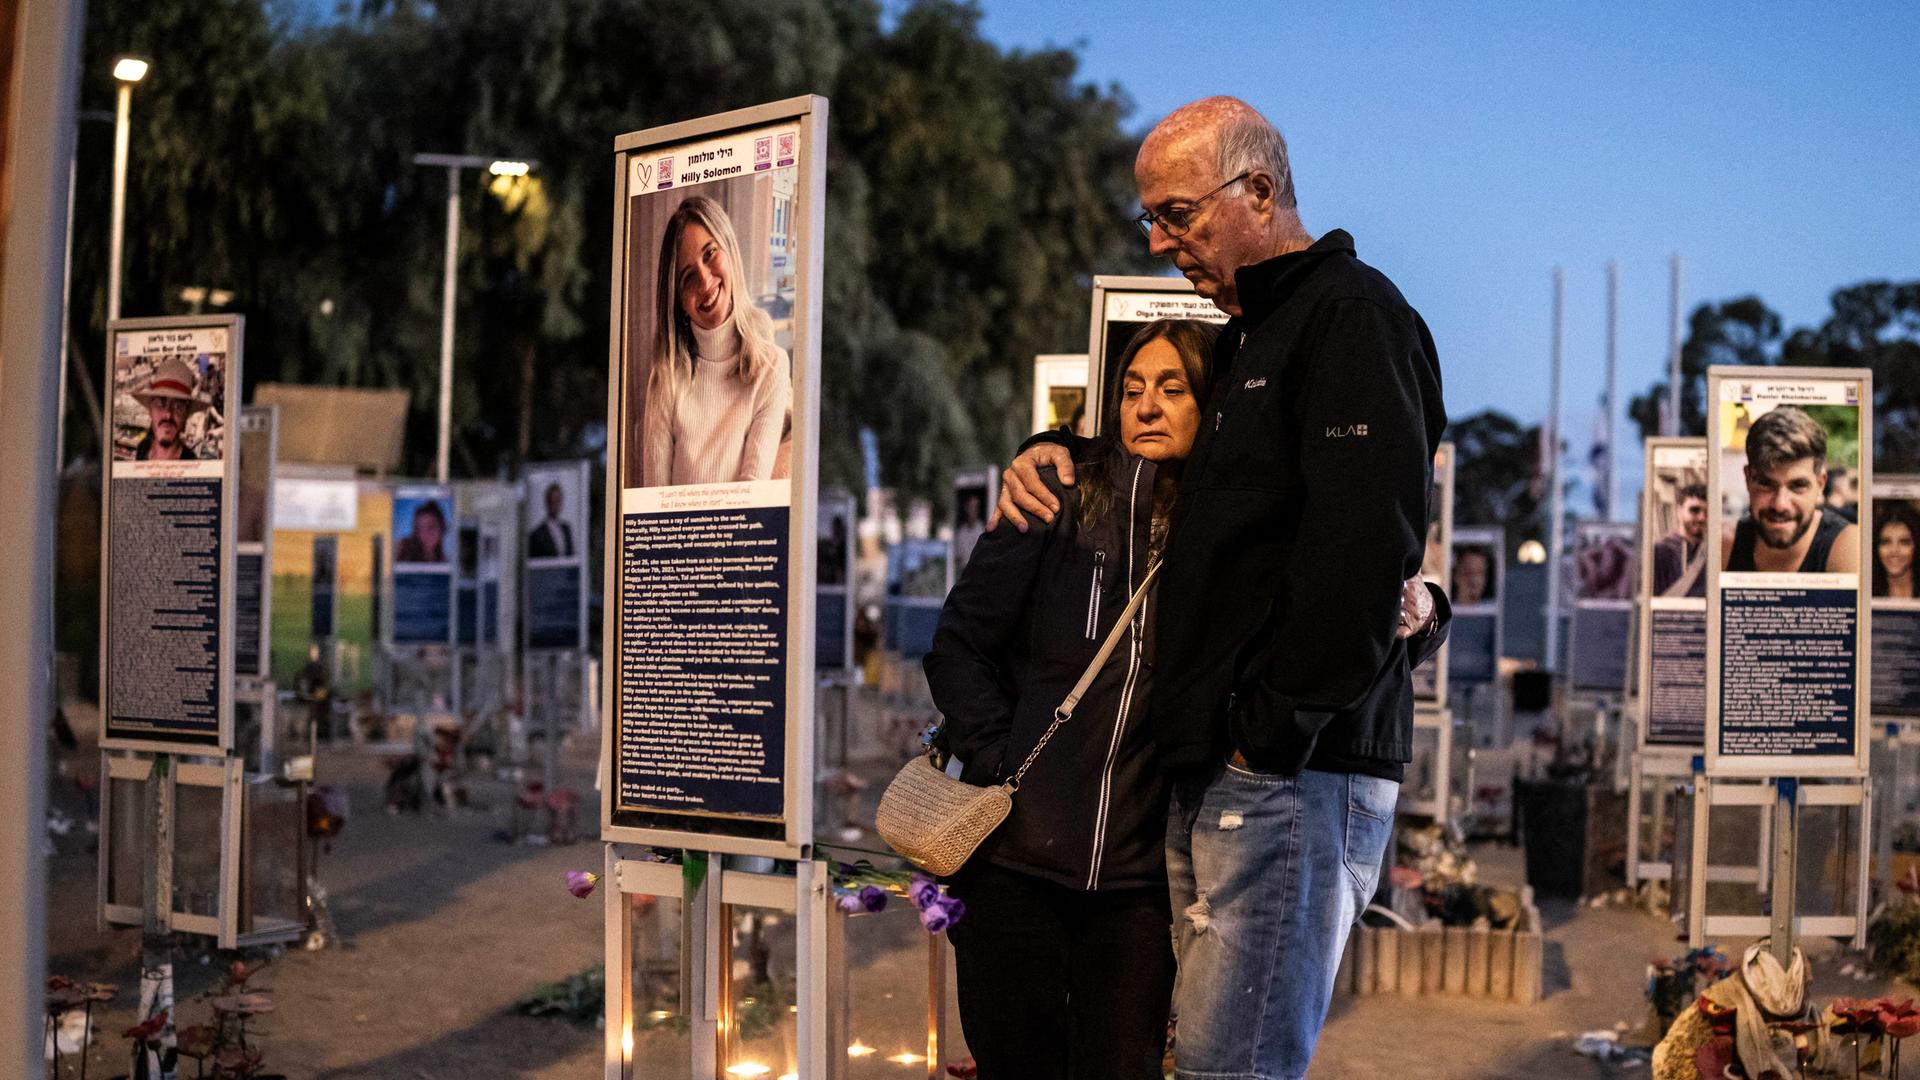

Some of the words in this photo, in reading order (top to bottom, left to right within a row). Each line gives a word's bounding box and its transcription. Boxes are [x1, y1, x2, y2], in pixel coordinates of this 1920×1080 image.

[688, 152, 714, 166] סולומון
[717, 148, 732, 158] הילי
[682, 172, 701, 183] Hilly
[704, 166, 741, 178] Solomon
